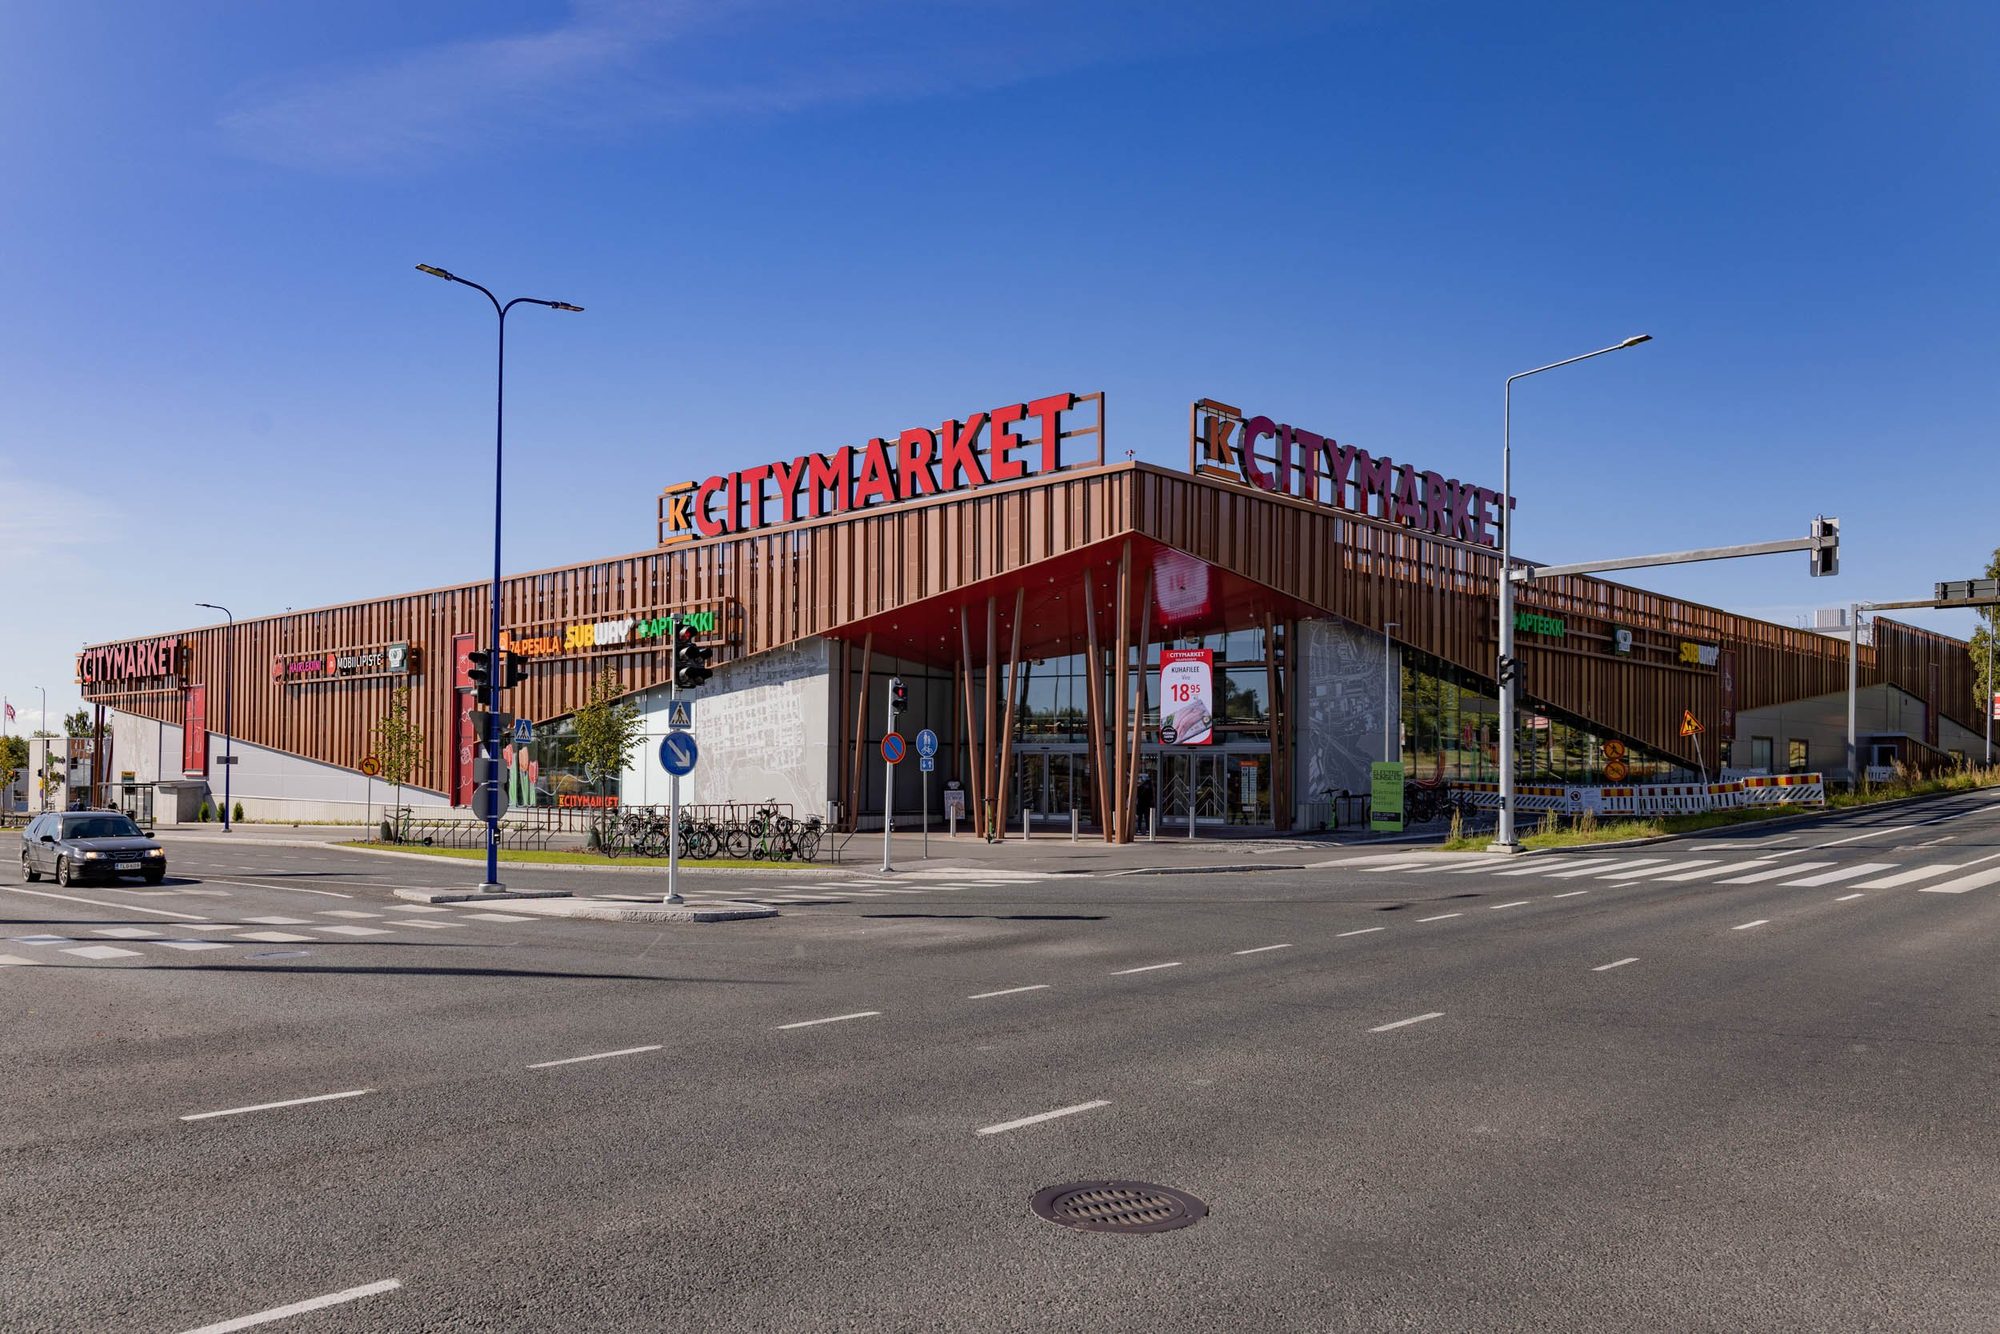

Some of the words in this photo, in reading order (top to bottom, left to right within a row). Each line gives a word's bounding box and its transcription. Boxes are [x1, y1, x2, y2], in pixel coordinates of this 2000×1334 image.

[668, 495, 692, 531] K
[695, 392, 1074, 537] CITYMARKET
[1239, 415, 1516, 548] CITYMARKET
[564, 618, 634, 650] SUBWAY
[650, 611, 713, 637] APTEKKI
[1519, 613, 1564, 637] APTEEKKI
[521, 635, 559, 654] PESULA
[83, 638, 177, 683] CITYMARKET
[1171, 683, 1190, 702] 18
[1190, 684, 1201, 693] 95
